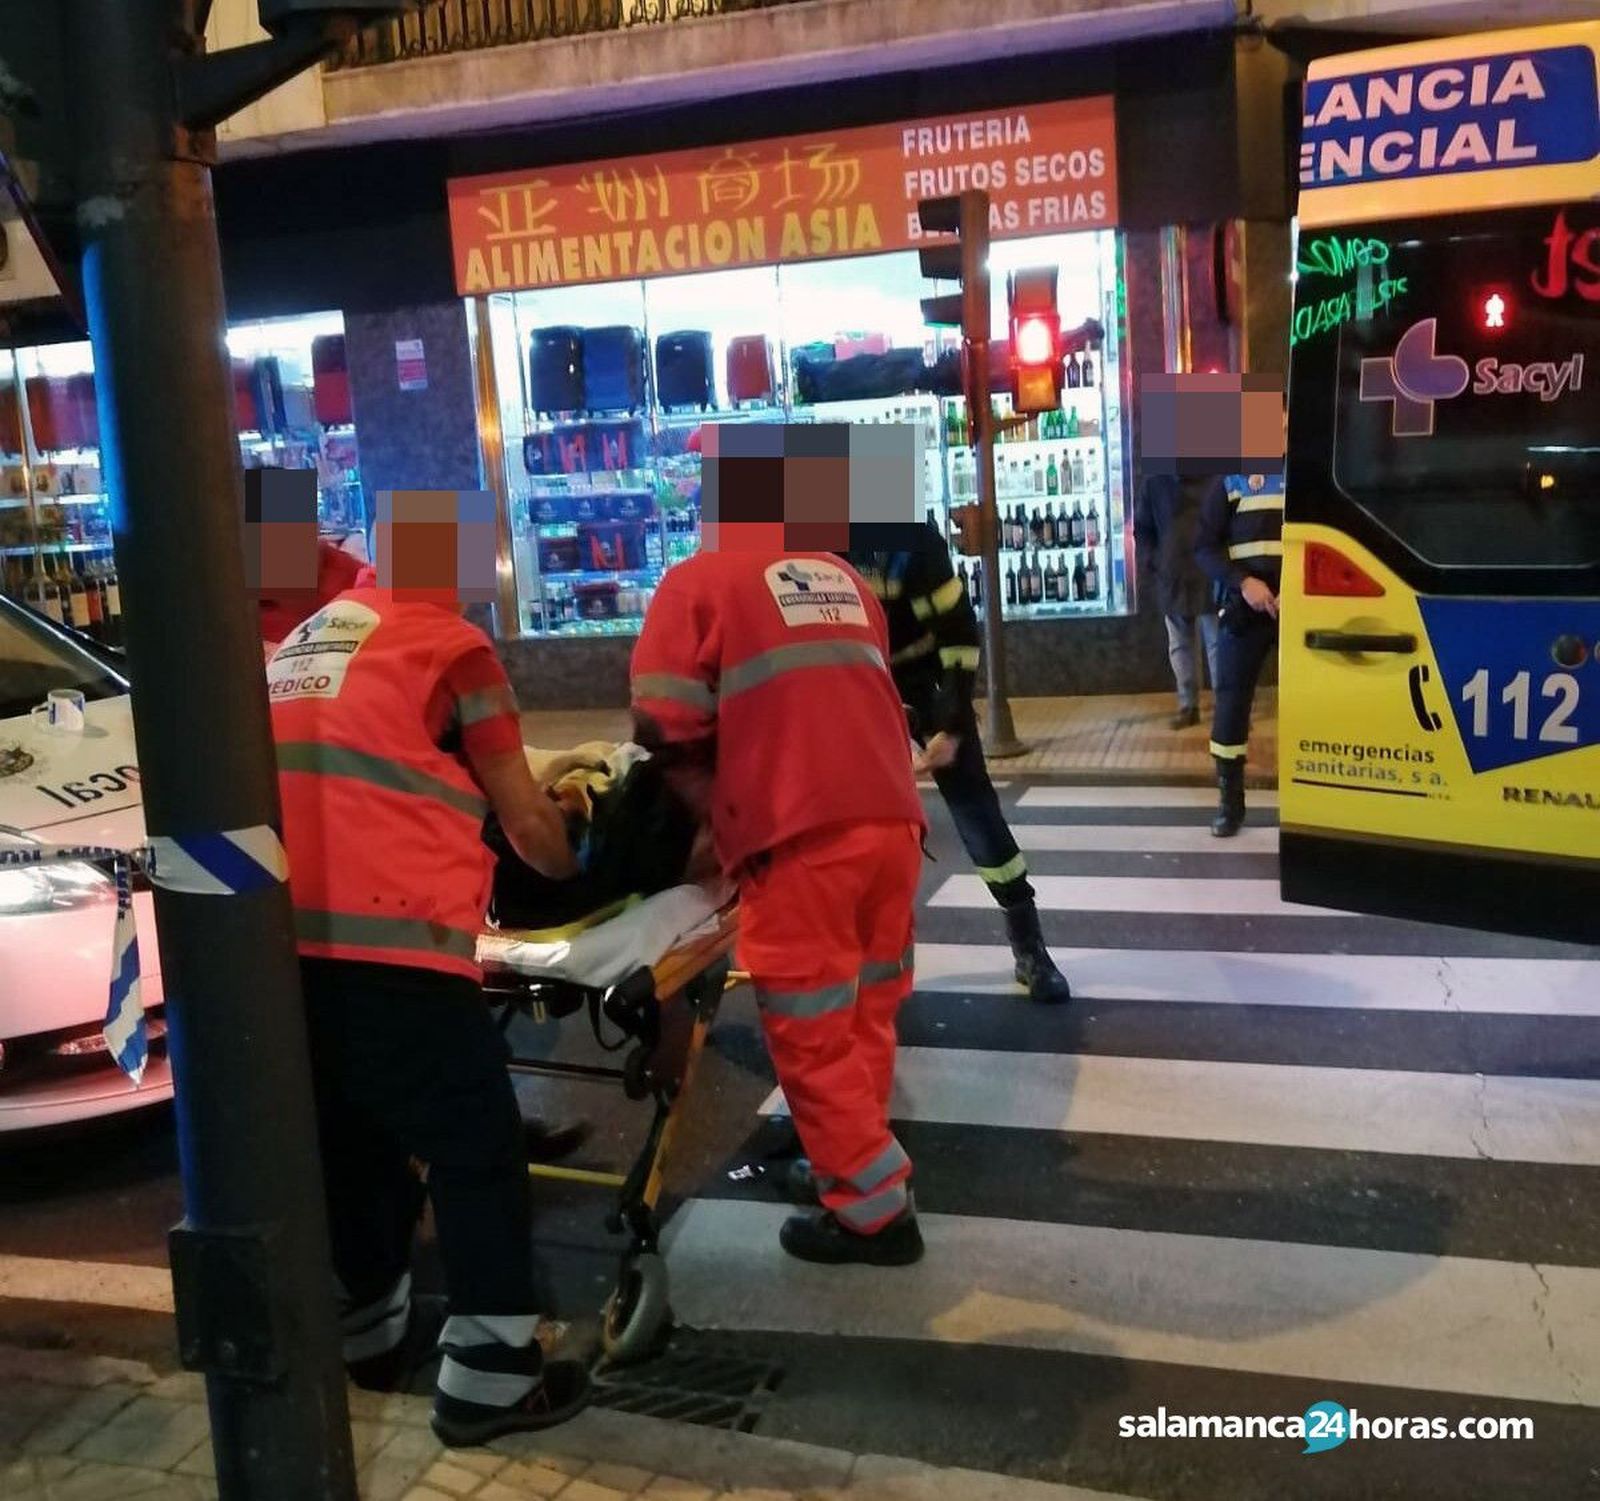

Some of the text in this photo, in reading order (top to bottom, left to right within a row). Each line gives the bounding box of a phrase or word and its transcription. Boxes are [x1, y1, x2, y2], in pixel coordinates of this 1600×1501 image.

[902, 114, 1031, 158] FRUTERIA
[904, 148, 1105, 200] FRUTOS SECOS
[1028, 190, 1106, 227] FRIAS
[465, 215, 766, 292] ALIMENTACION
[779, 202, 882, 257] ASIA
[1473, 353, 1584, 402] Sacyl
[819, 607, 841, 623] 112
[268, 676, 331, 694] EDICO
[1461, 668, 1580, 744] 112
[1299, 739, 1435, 763] emergencias
